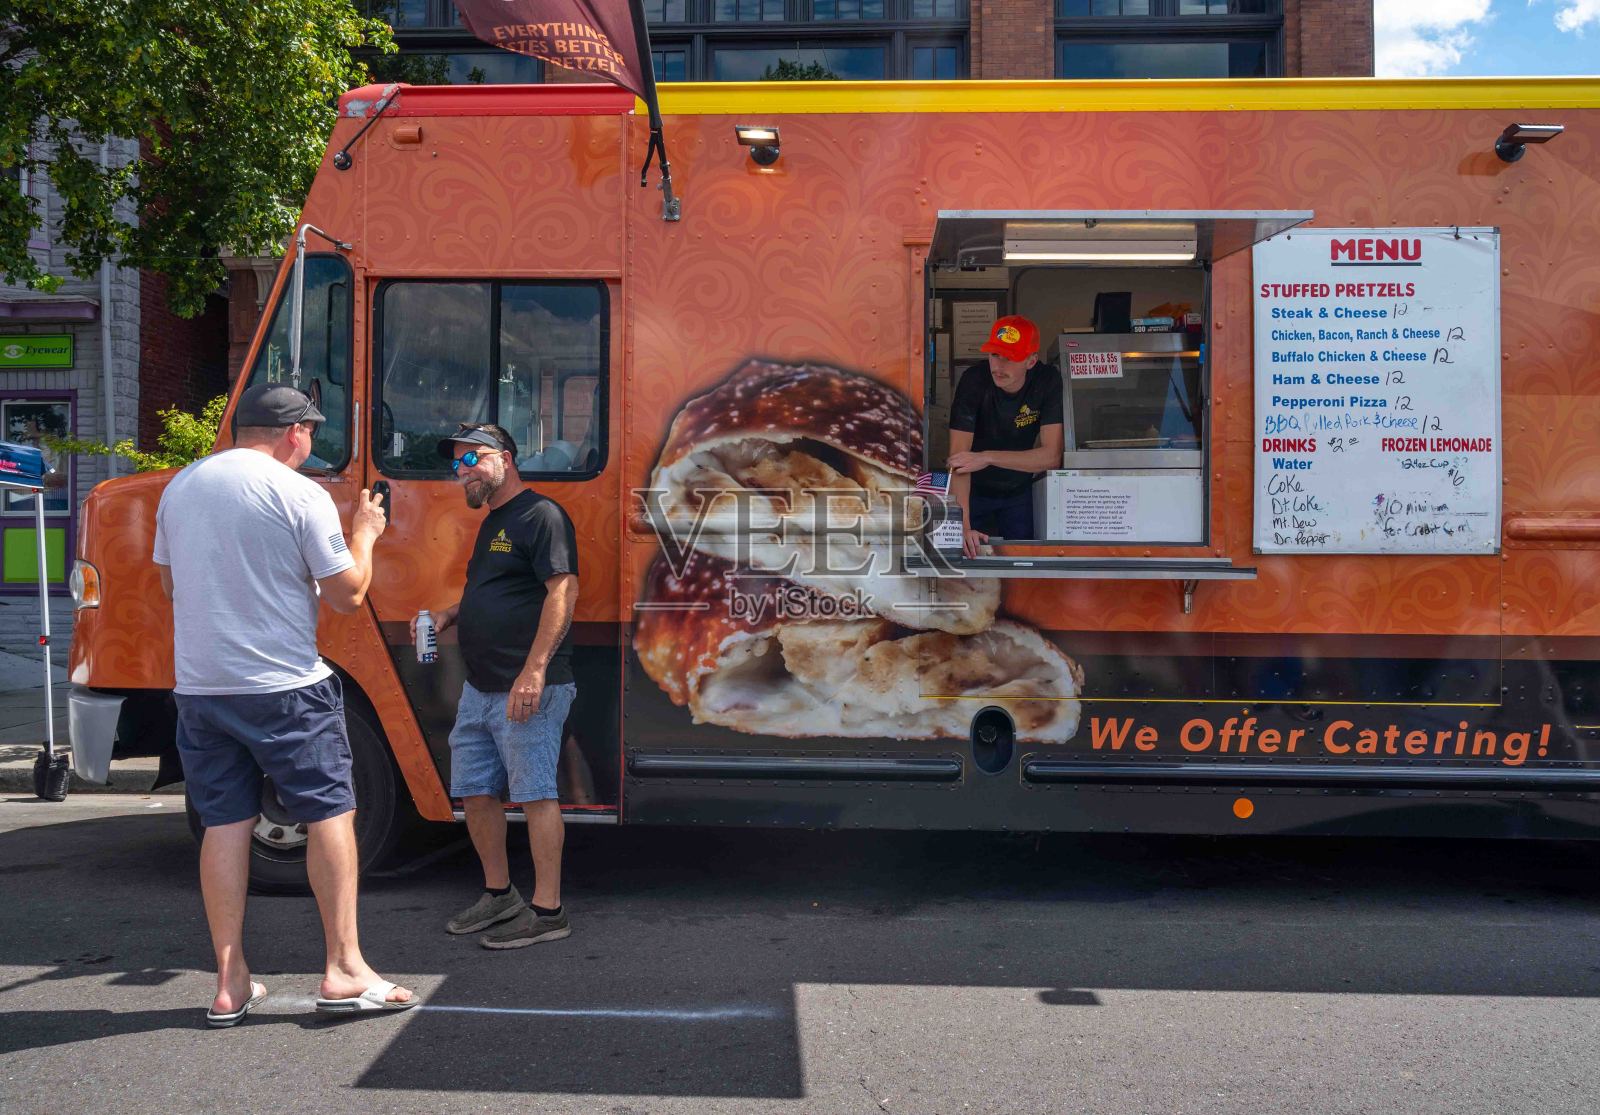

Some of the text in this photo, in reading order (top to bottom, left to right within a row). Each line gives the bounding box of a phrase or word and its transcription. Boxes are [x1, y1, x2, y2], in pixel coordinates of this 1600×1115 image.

[493, 22, 610, 47] EVERYTHING
[554, 40, 625, 67] BETTER
[1331, 239, 1422, 261] MENU
[1260, 282, 1415, 298] STUFFED PRETZELS
[1271, 303, 1409, 319] Steak & Cheese 12
[1271, 326, 1466, 342] Chicken, Bacon, Ranch & Cheese 12
[1070, 353, 1087, 364] NEED
[1271, 347, 1455, 364] Buffalo Chicken & Cheese 12
[1071, 365, 1088, 375] PLEASE
[1093, 365, 1108, 375] THANK
[1109, 364, 1119, 375] YOU
[1272, 370, 1406, 386] Ham & Cheese 12
[1272, 395, 1414, 411] Pepperoni Pizza 12
[1265, 414, 1301, 435] BBQ
[1422, 415, 1443, 434] 12
[1262, 438, 1317, 453] DRINKS
[1381, 437, 1492, 452] FROZEN LEMONADE
[1272, 457, 1313, 470] Water
[1430, 458, 1449, 468] Cup
[1293, 515, 1317, 529] Dew
[1090, 717, 1552, 766] We Offer Catering!
